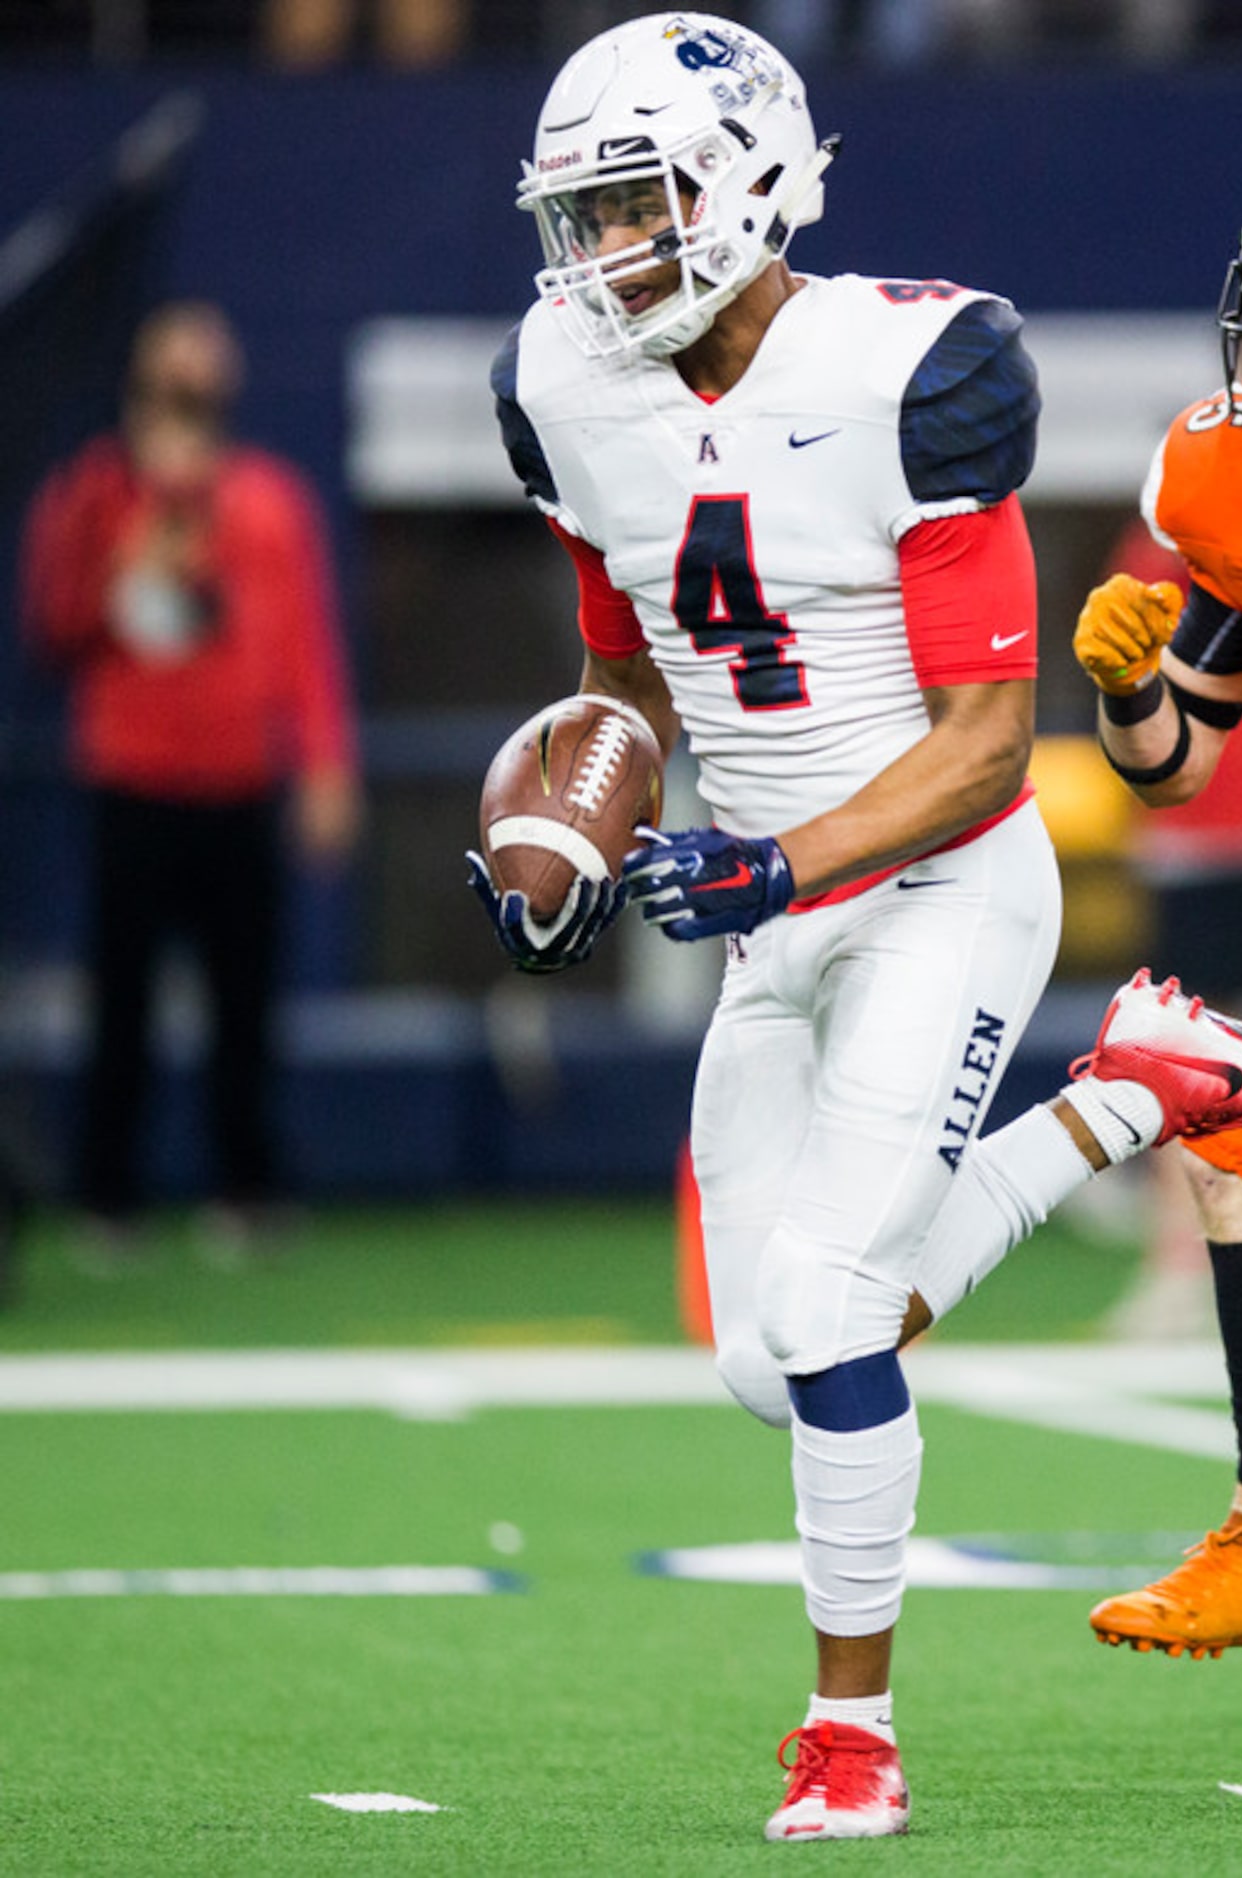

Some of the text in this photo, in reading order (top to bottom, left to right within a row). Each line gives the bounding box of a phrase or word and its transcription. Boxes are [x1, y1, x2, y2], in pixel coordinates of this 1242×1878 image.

[696, 433, 720, 465] A
[671, 493, 812, 713] 4
[938, 1007, 1006, 1176] ALLEN
